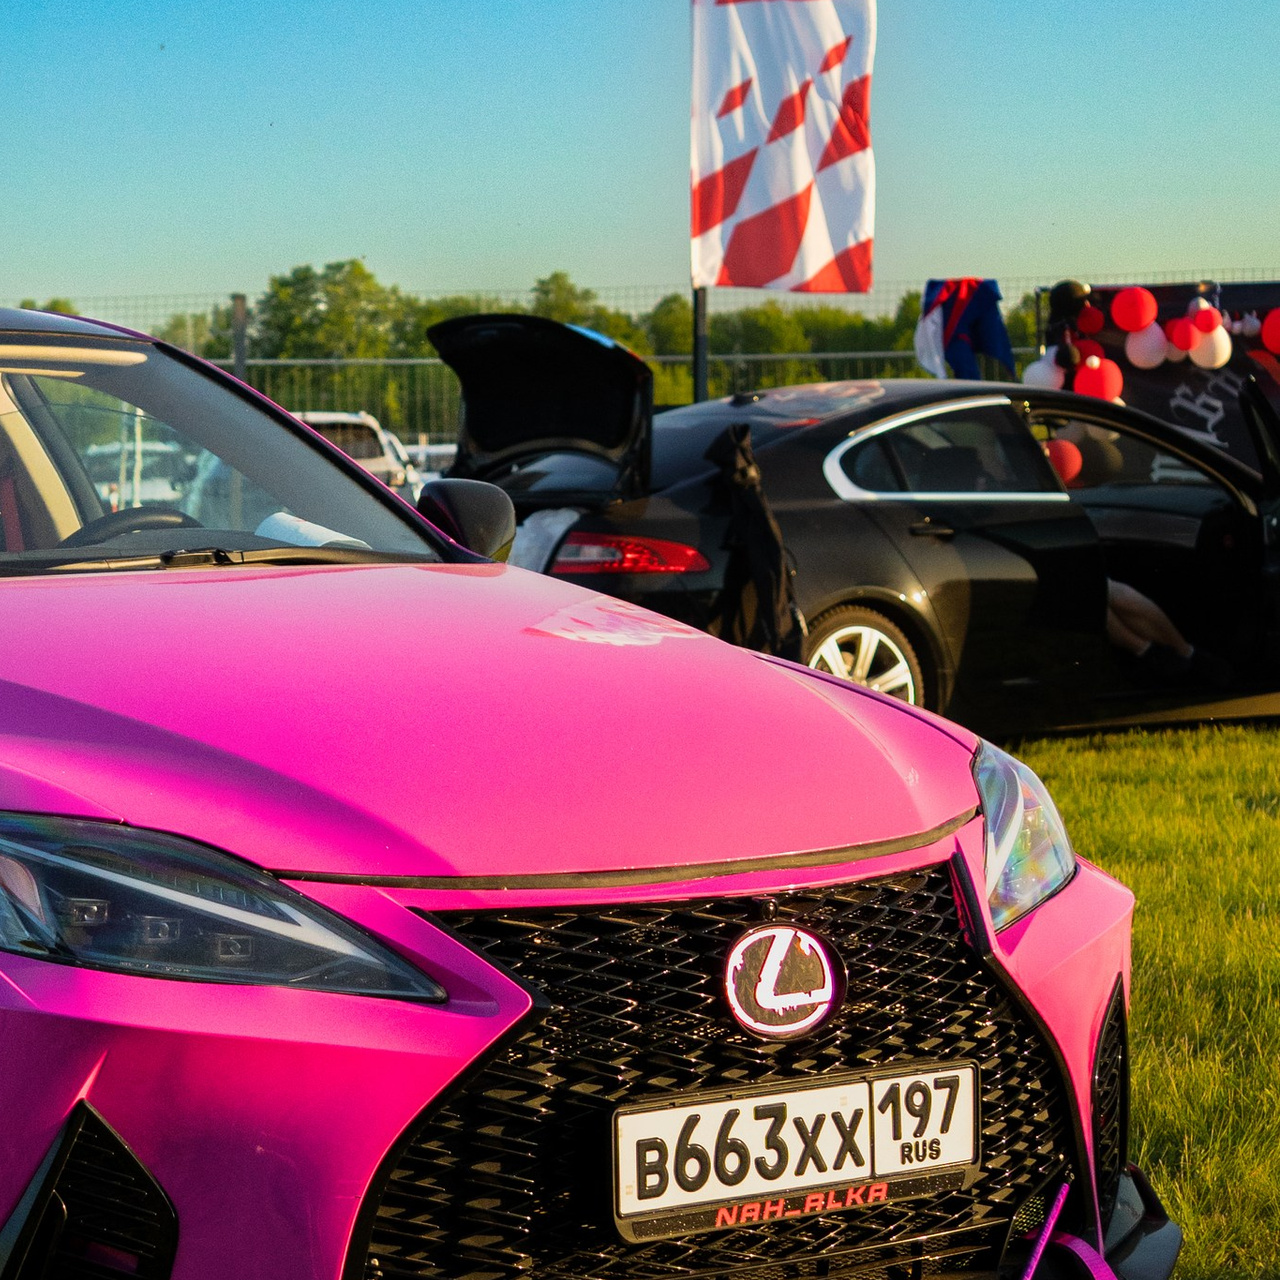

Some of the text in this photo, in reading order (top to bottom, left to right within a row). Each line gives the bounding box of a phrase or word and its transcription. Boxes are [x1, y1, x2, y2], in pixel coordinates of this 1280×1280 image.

[878, 1075, 960, 1141] 197
[900, 1138, 941, 1165] RUS
[715, 1182, 889, 1228] NAH_ALKA
